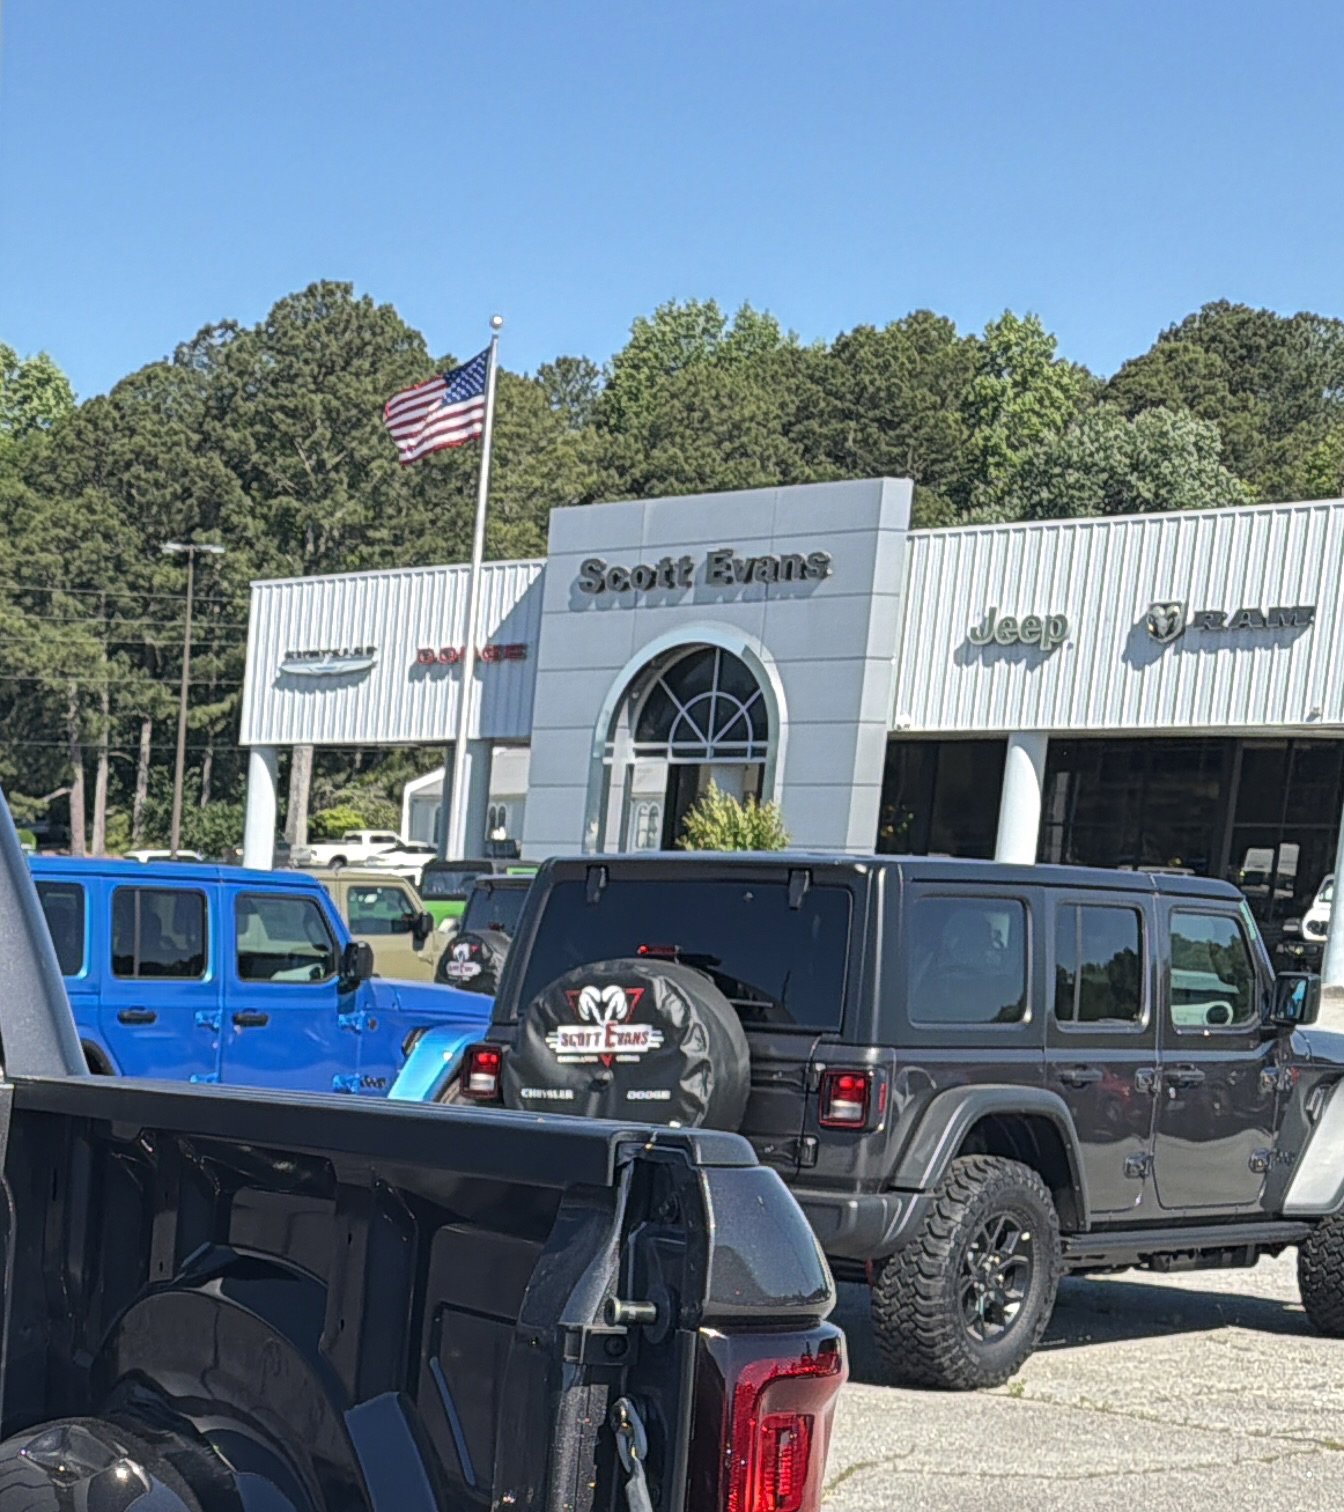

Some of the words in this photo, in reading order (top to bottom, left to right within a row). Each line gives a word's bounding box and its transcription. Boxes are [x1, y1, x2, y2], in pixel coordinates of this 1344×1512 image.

[579, 555, 694, 594] Scott
[706, 549, 832, 585] Evans
[968, 605, 1069, 651] Jeep
[1193, 605, 1315, 630] RAM
[561, 1030, 602, 1048] SCOTT
[605, 1021, 650, 1049] EVANS
